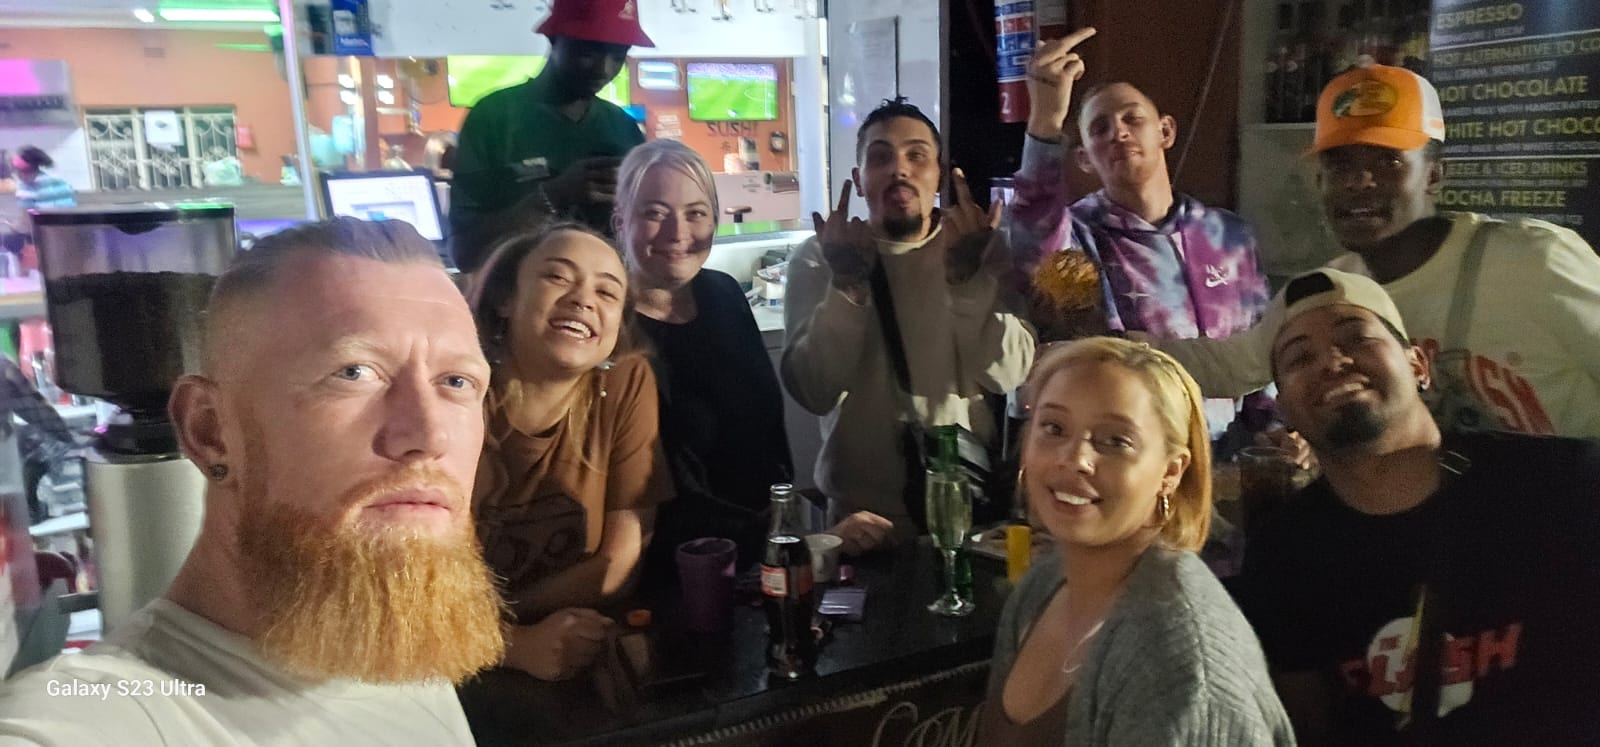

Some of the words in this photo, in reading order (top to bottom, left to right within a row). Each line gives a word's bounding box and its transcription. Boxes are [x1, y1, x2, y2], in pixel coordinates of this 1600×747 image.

[1437, 3, 1522, 29] ESPRESSO
[1554, 40, 1575, 54] TO
[1472, 76, 1588, 100] CHOCOLATE
[706, 120, 758, 137] SUSHI
[1445, 122, 1484, 138] HITE
[1489, 119, 1527, 138] HOT
[1531, 161, 1587, 175] DRINKS
[1501, 190, 1566, 207] FREEZE
